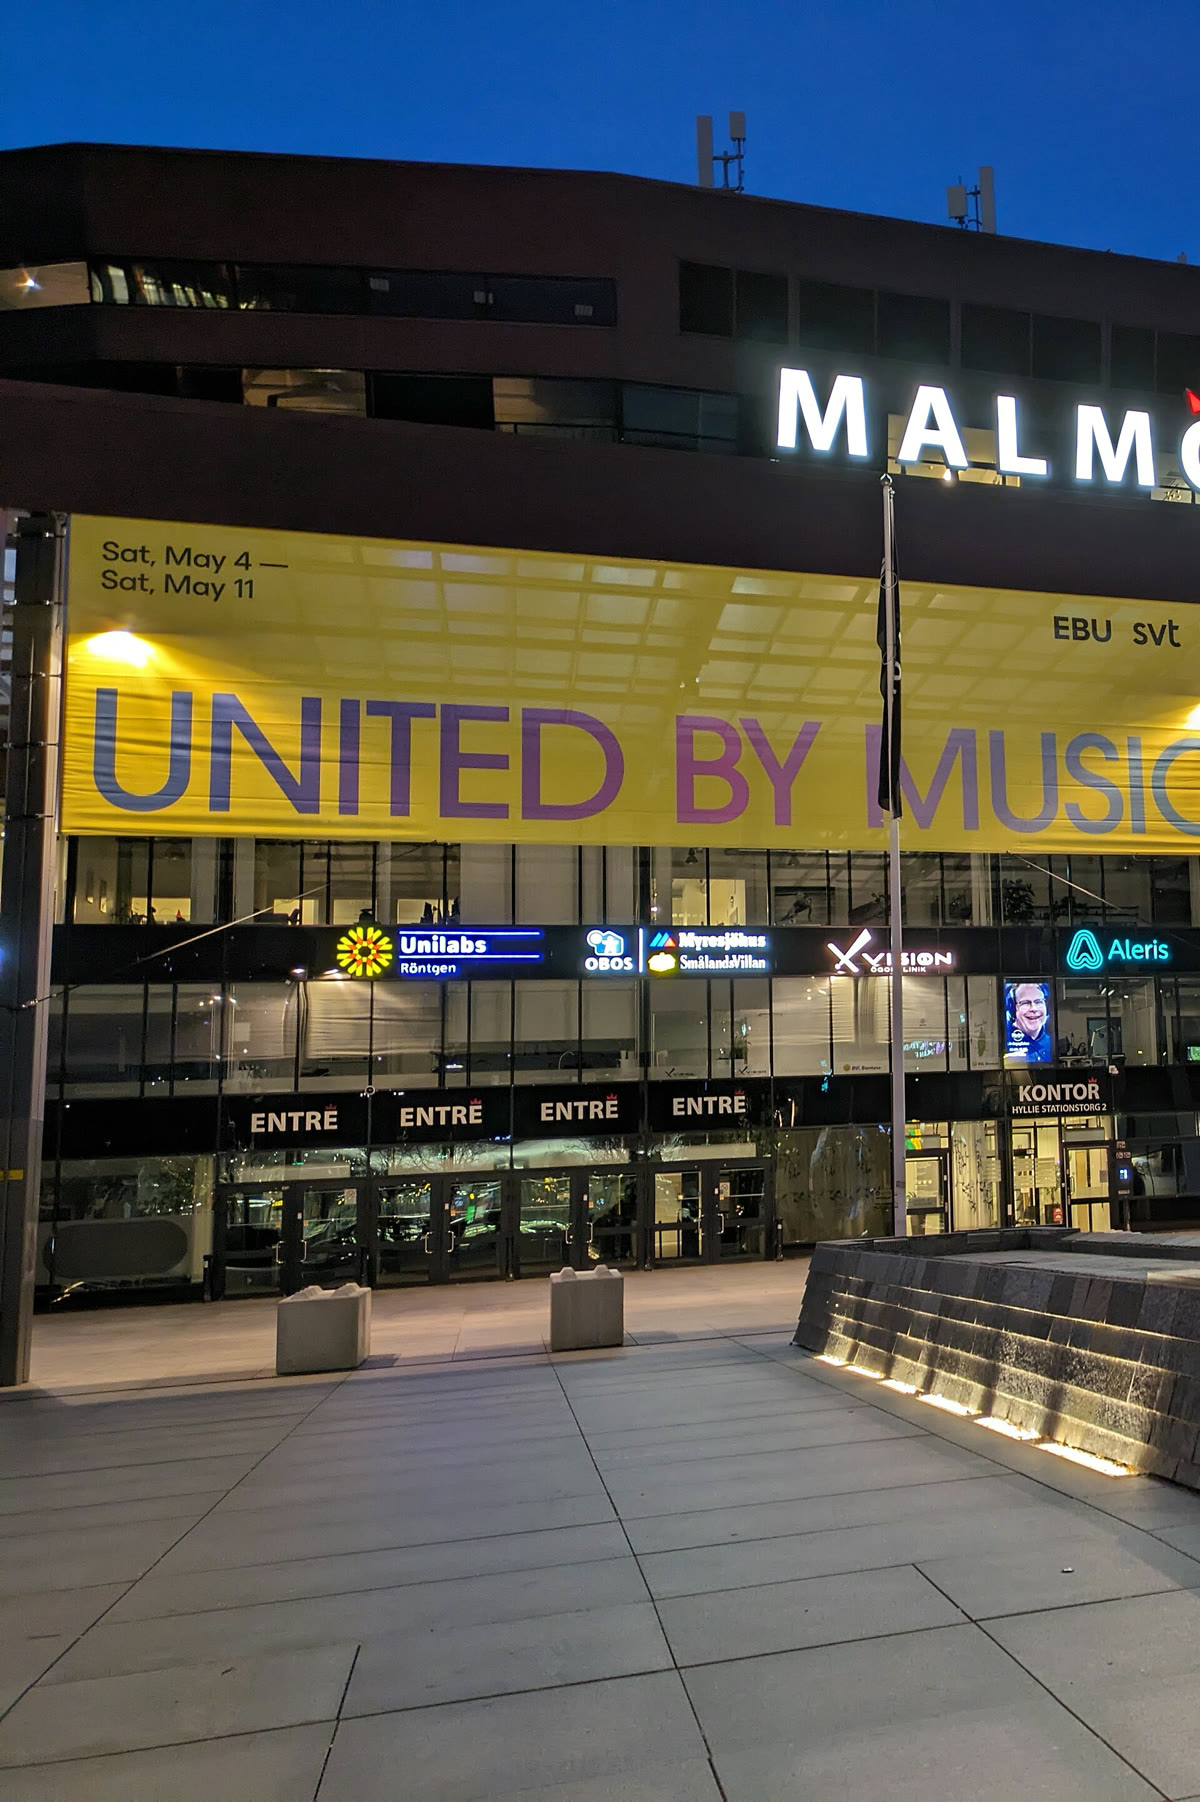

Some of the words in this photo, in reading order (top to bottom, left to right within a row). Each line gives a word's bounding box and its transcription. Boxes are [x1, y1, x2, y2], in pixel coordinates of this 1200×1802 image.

[102, 541, 156, 567] Sat,
[165, 546, 226, 574] May
[234, 551, 252, 571] 4
[101, 569, 154, 595] Sat,
[164, 574, 226, 602] May
[234, 579, 254, 599] 11
[1054, 616, 1112, 643] EBU
[1133, 619, 1181, 648] svt
[93, 687, 625, 820] UNITED
[675, 715, 822, 826] BY
[400, 934, 487, 954] Unilabs
[679, 931, 766, 950] Myresjöhus
[1108, 938, 1169, 960] Aleris
[400, 962, 457, 976] Röntgen
[584, 957, 633, 970] OBOS
[1019, 1083, 1100, 1102] KONTOR
[1012, 1104, 1040, 1114] HYLLIE
[1041, 1103, 1100, 1113] STATIONSTORG
[1102, 1102, 1107, 1111] 2
